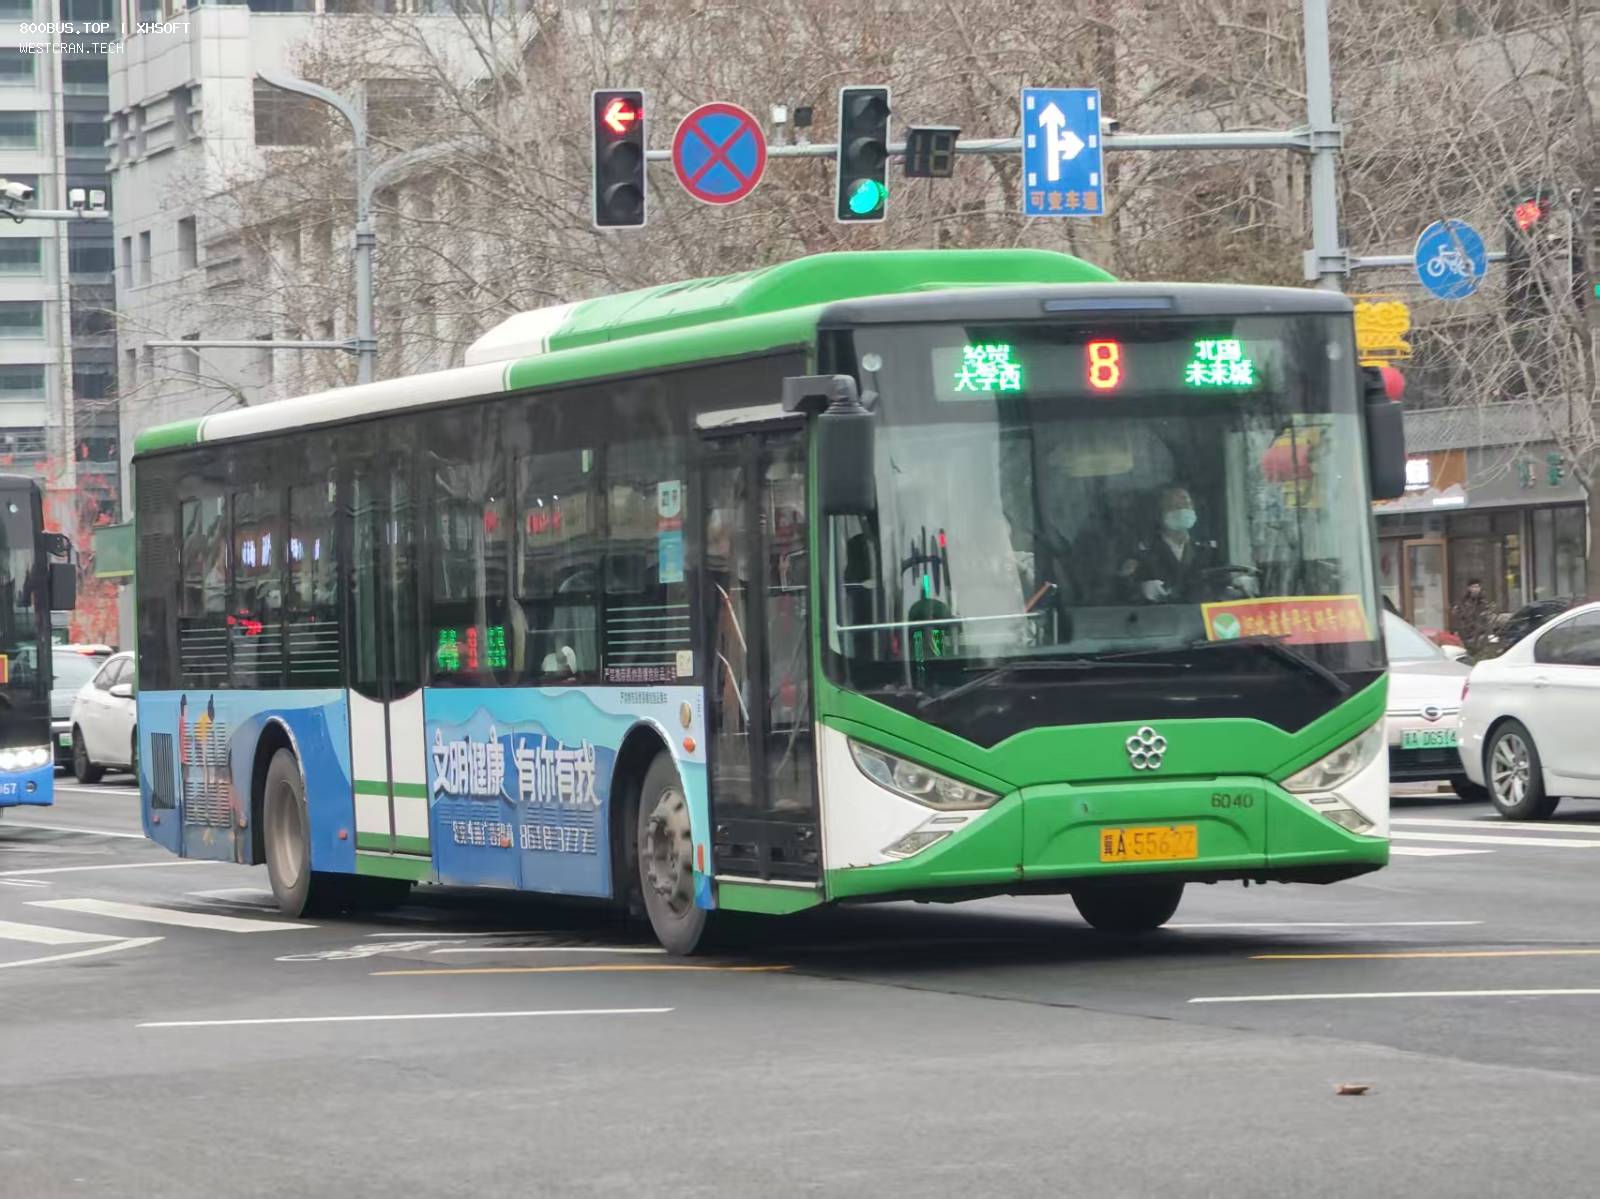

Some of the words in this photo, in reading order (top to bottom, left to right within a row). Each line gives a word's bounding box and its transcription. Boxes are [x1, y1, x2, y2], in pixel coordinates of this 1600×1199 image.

[954, 363, 1021, 391] 大学西
[1087, 341, 1120, 389] 8
[1185, 360, 1253, 385] 未来城
[431, 729, 511, 800] 文明健康
[516, 736, 602, 804] 有你有我
[1210, 792, 1254, 809] 6040
